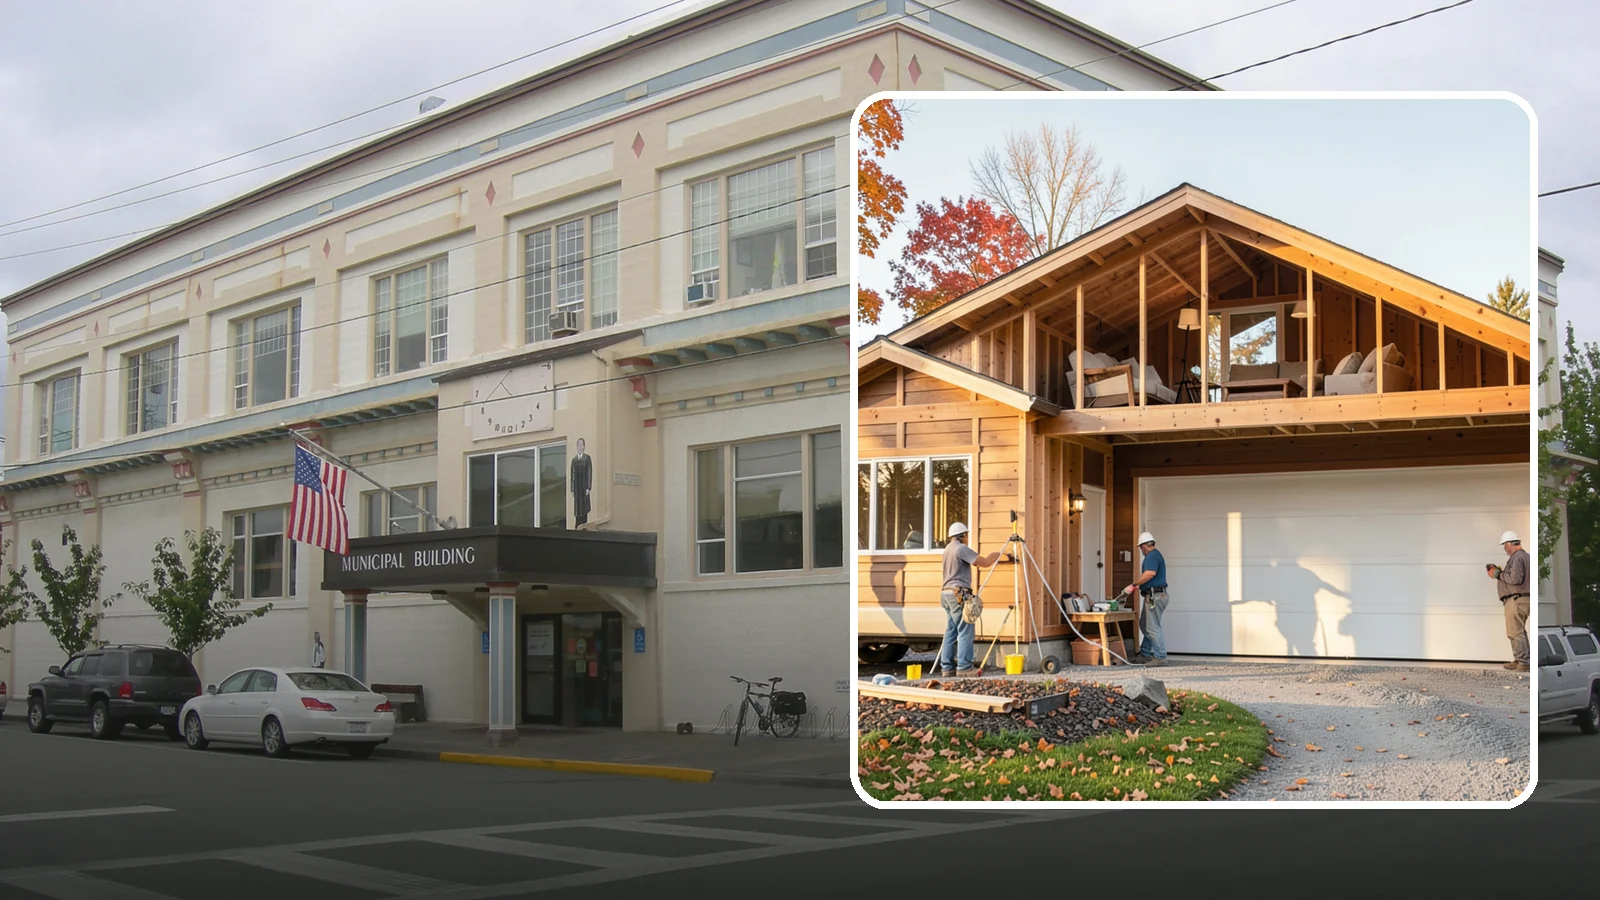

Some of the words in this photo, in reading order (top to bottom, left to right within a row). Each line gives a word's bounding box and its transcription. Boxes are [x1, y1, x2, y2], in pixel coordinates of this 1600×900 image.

[487, 417, 492, 426] 9
[494, 424, 500, 432] 10
[501, 425, 506, 434] 11
[507, 425, 513, 433] 12
[521, 420, 525, 428] 2
[528, 413, 533, 422] 3
[536, 402, 540, 410] 4
[342, 552, 405, 572] MUNICIPAL
[414, 546, 475, 567] BUILDING
